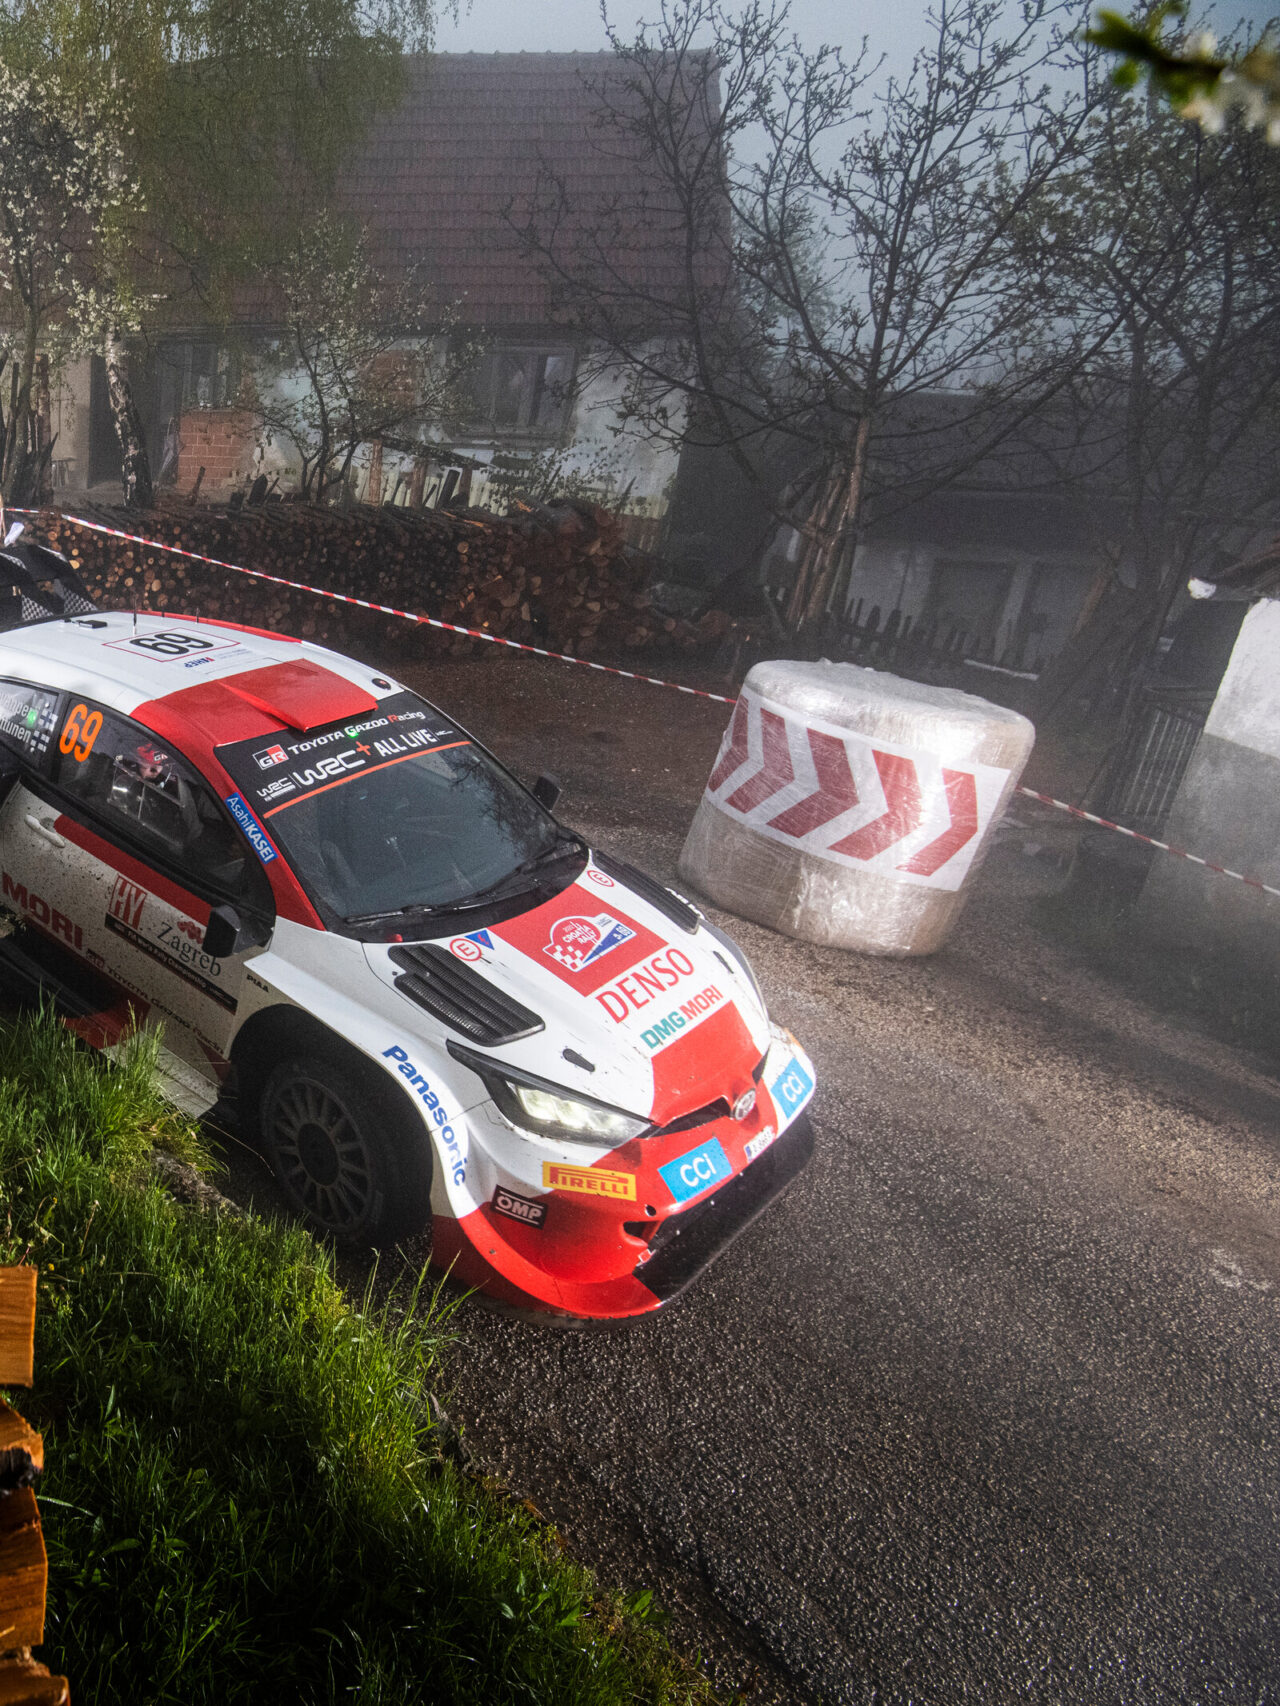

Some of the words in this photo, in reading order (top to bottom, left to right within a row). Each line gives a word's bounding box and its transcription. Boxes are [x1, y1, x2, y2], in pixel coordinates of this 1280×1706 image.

[129, 632, 214, 655] 69
[59, 704, 104, 762] 69
[258, 751, 287, 769] GR
[288, 731, 344, 755] TOYOTA
[344, 718, 389, 738] GAZOO
[387, 710, 425, 723] Racing
[256, 776, 294, 797] WRC
[373, 734, 407, 757] ALL
[400, 728, 438, 749] LIVE
[1, 871, 83, 950] MORI
[562, 925, 592, 943] CROATIA
[577, 929, 597, 944] RALLY
[157, 922, 222, 977] Zagreb
[106, 965, 149, 998] TOYOTA
[246, 974, 269, 993] PIAA
[595, 948, 694, 1024] DENSO
[640, 1011, 686, 1049] DMG
[679, 984, 724, 1021] MORI
[382, 1045, 468, 1187] Panasonic
[497, 1194, 545, 1220] OMP
[549, 1166, 629, 1196] PIRELLI
